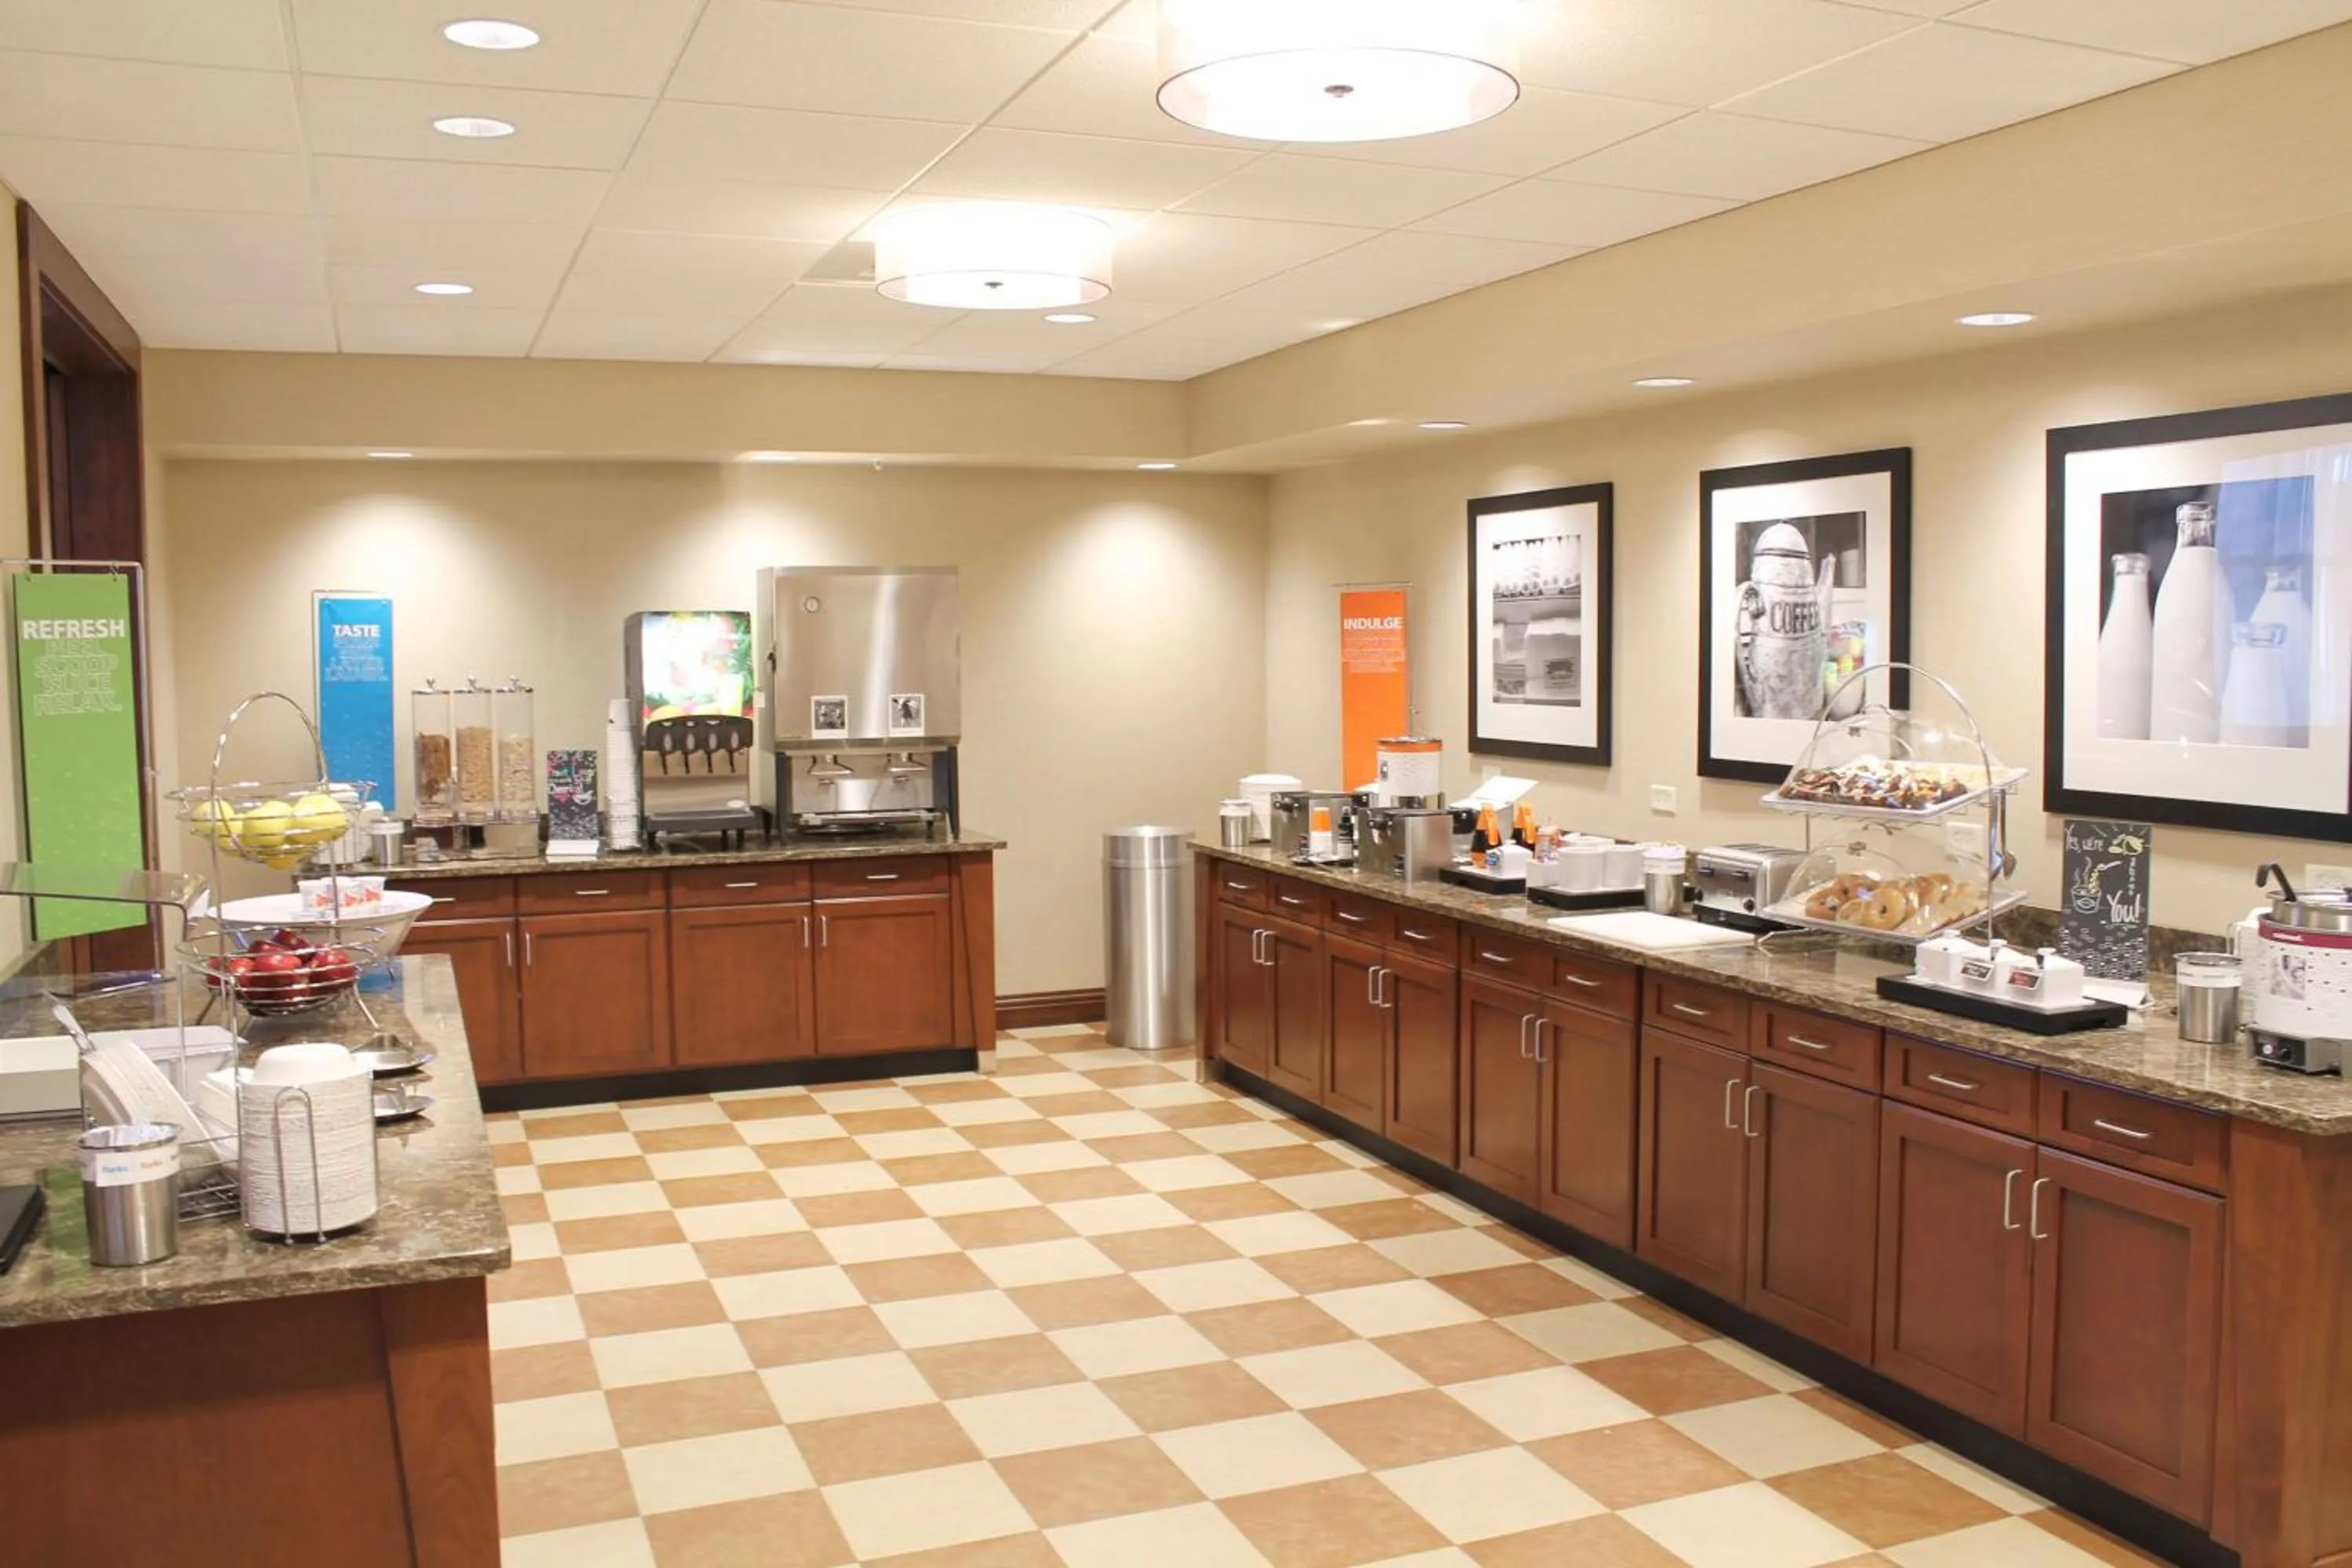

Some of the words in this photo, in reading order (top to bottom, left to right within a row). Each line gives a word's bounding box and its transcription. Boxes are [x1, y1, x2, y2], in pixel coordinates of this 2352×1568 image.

[22, 618, 126, 641] REFRESH
[331, 623, 381, 637] TASTE
[1343, 616, 1403, 630] INDULGE
[2106, 890, 2141, 924] You!
